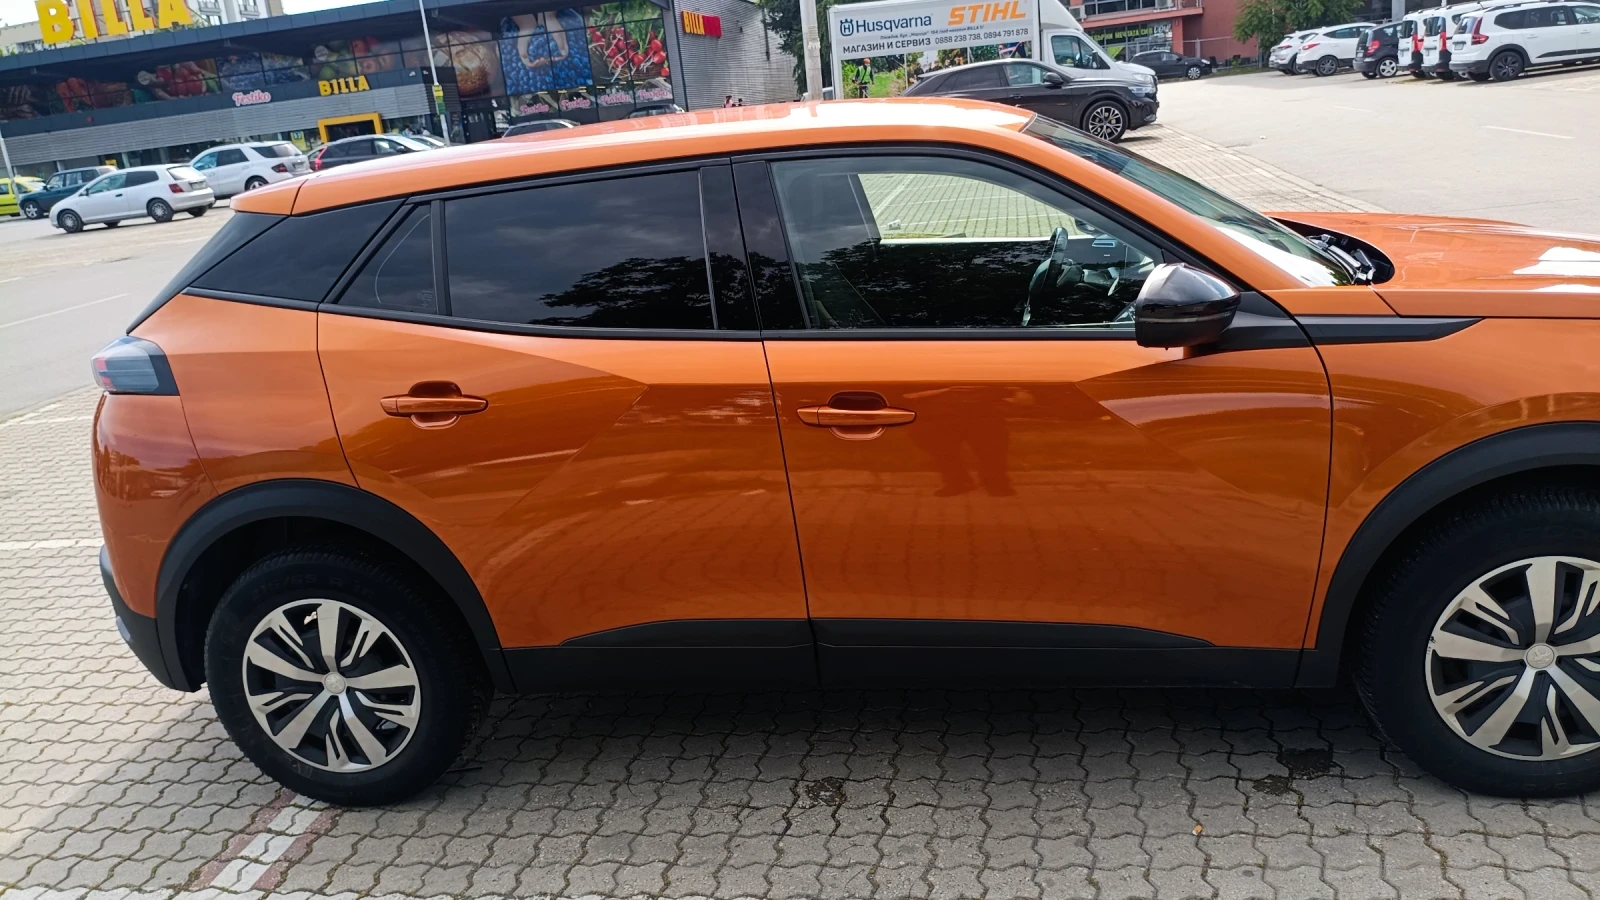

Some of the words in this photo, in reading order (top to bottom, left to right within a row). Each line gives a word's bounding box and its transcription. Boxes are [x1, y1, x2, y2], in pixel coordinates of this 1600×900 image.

[36, 0, 193, 44] BILLA
[682, 10, 705, 35] BILLA
[856, 15, 932, 34] Husqvarna
[948, 0, 1026, 26] STIHL
[843, 42, 885, 54] МАГАЗИН
[887, 41, 893, 50] И
[895, 37, 931, 48] СЕРВИЗ
[935, 36, 952, 44] 0888
[983, 31, 1001, 40] 0894
[1003, 29, 1015, 37] 791
[232, 89, 271, 106] Festiko
[318, 75, 370, 96] BILLA
